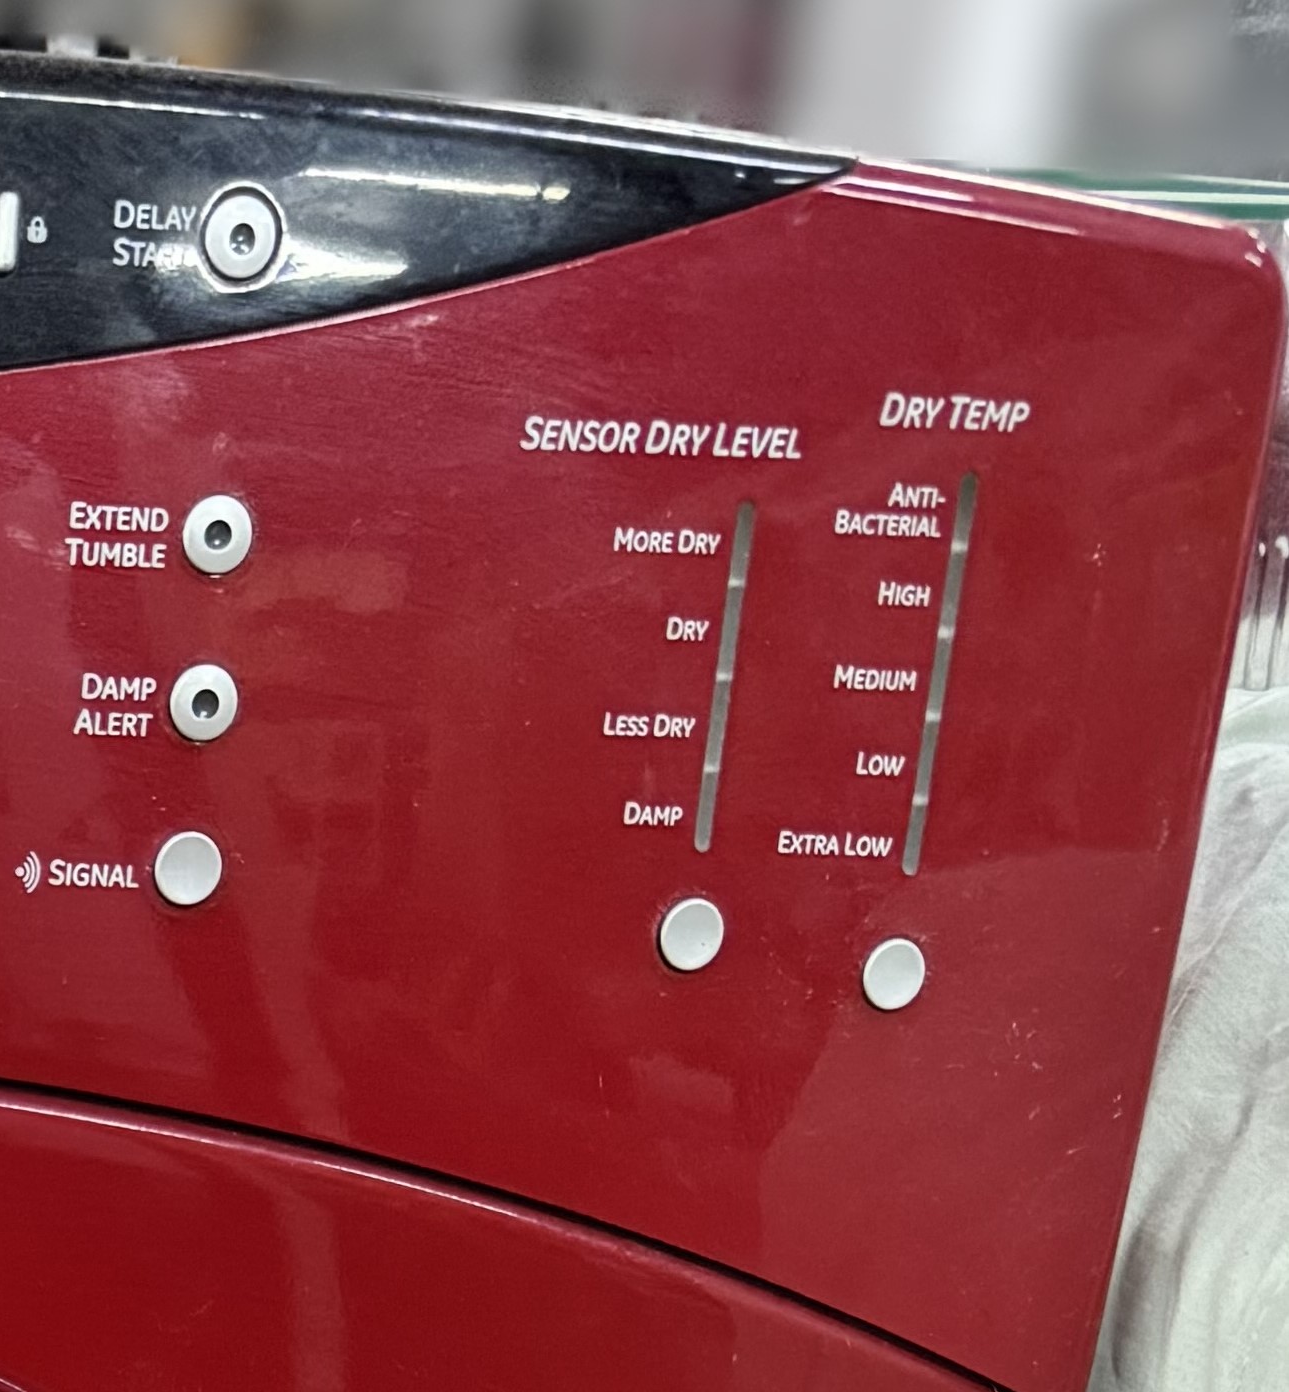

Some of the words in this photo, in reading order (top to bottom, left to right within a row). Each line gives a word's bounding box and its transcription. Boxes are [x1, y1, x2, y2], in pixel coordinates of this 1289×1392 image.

[113, 199, 197, 231] DELAY
[112, 237, 196, 268] STA
[880, 392, 944, 430] DRY
[949, 396, 1030, 433] TEMP
[520, 416, 640, 453] SENSOR
[645, 419, 711, 457] DRY
[713, 422, 802, 460] LEVEL
[888, 483, 946, 510] ANTI-
[68, 502, 169, 532] EXTEND
[835, 511, 941, 538] BACTERIAL
[64, 538, 167, 569] TUMBLE
[613, 527, 673, 554] MORE
[678, 531, 721, 556] DRY
[878, 582, 930, 607] HIGH
[667, 617, 709, 642] DRY
[81, 673, 156, 701] DAMP
[834, 665, 917, 692] MEDIUM
[73, 708, 153, 739] ALERT
[603, 713, 648, 736] LESS
[653, 715, 696, 739] DRY
[856, 752, 905, 777] LOW
[623, 801, 683, 827] DAMP
[777, 831, 839, 855] EXTRA
[845, 832, 892, 858] LOW
[48, 858, 139, 889] SIGNAL
